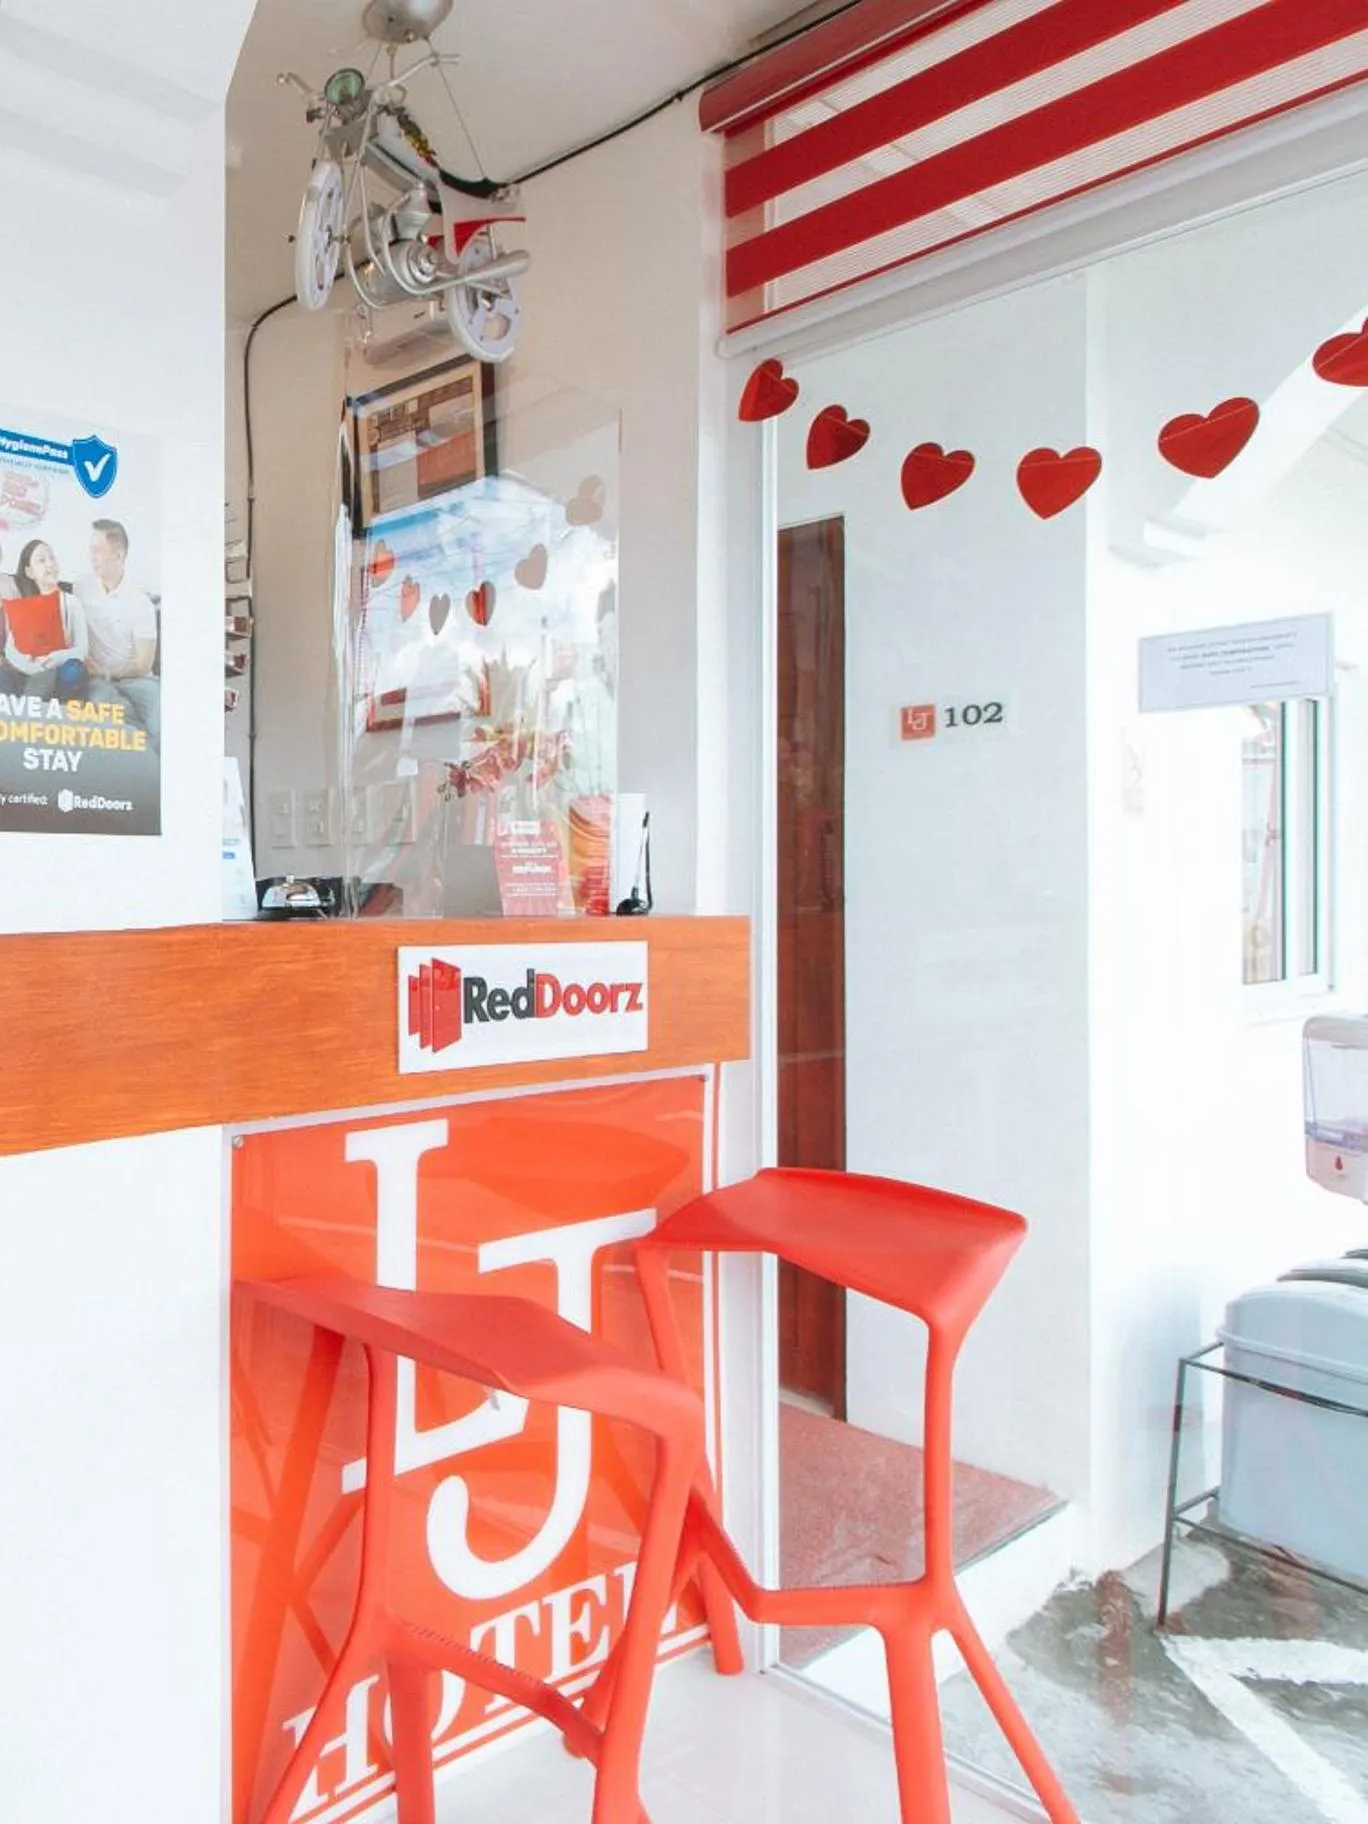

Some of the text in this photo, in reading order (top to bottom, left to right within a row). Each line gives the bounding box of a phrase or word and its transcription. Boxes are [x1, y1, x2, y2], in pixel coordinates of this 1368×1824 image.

[46, 699, 62, 719] A
[66, 701, 124, 724] SAFE
[944, 702, 1003, 728] 102
[23, 748, 82, 771] STAY
[463, 968, 643, 1024] RedDoorz
